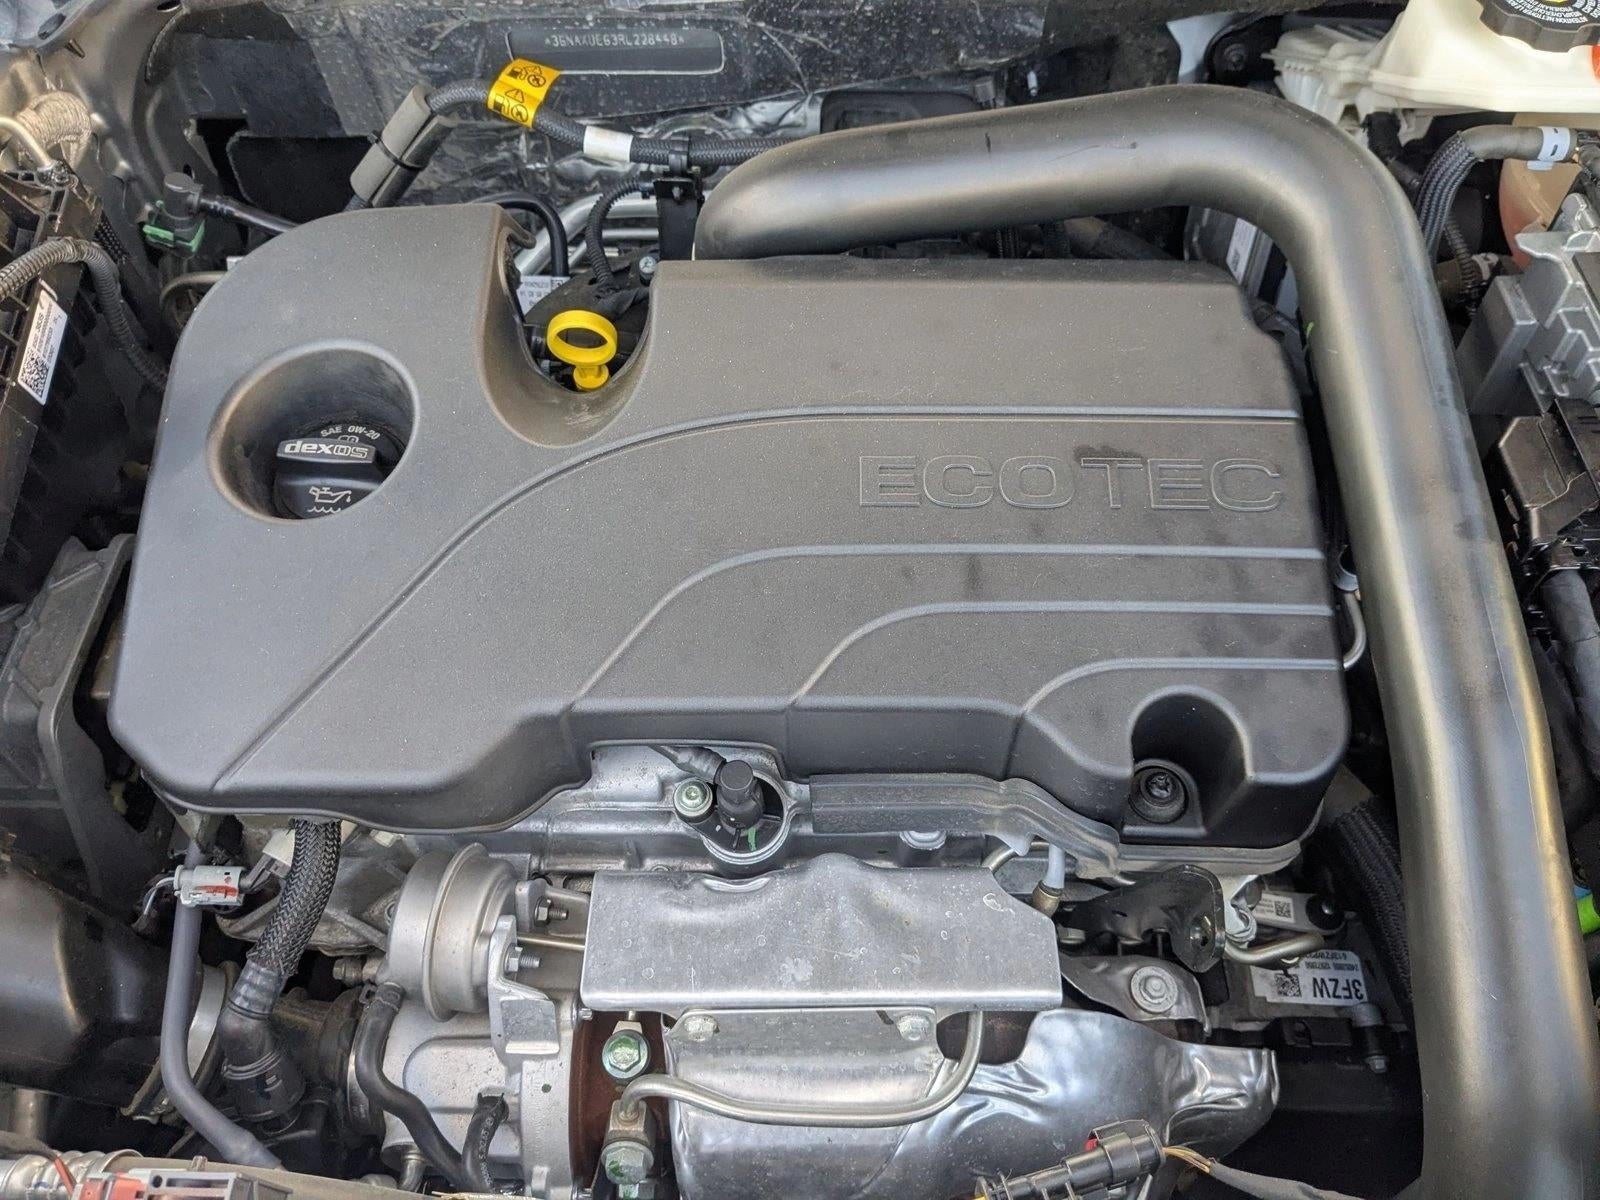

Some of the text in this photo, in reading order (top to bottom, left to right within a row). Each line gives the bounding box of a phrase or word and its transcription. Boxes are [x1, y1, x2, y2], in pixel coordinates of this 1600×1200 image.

[320, 426, 342, 437] SAE
[858, 453, 1282, 512] ECOTEC
[1312, 977, 1364, 1000] 3FZW
